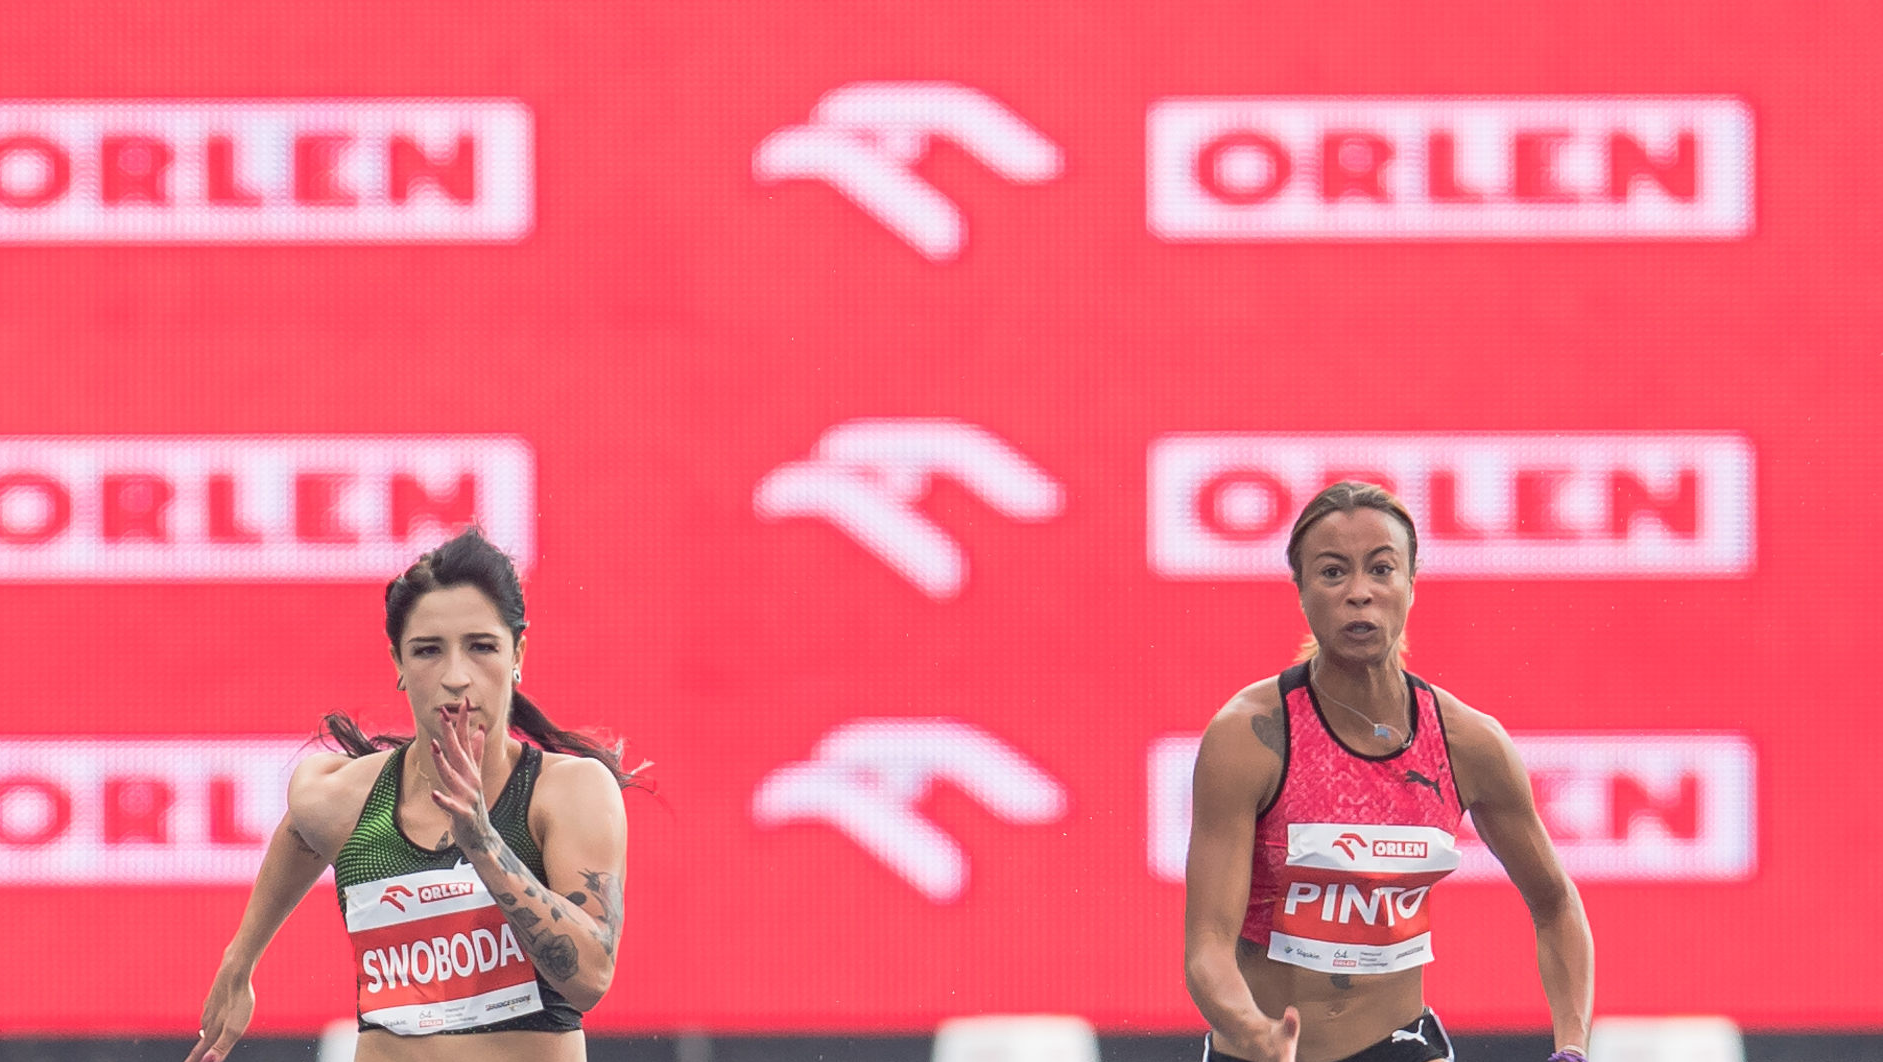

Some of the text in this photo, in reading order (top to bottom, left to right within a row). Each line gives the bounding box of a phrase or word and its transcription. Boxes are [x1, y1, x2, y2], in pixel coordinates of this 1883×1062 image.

[1198, 131, 1696, 206] ORLEN
[1198, 468, 1697, 541] OLEN
[1374, 842, 1426, 857] ORLEN
[420, 883, 471, 902] ORLEN
[1284, 882, 1431, 927] PINTO
[362, 923, 526, 994] SWOBODA
